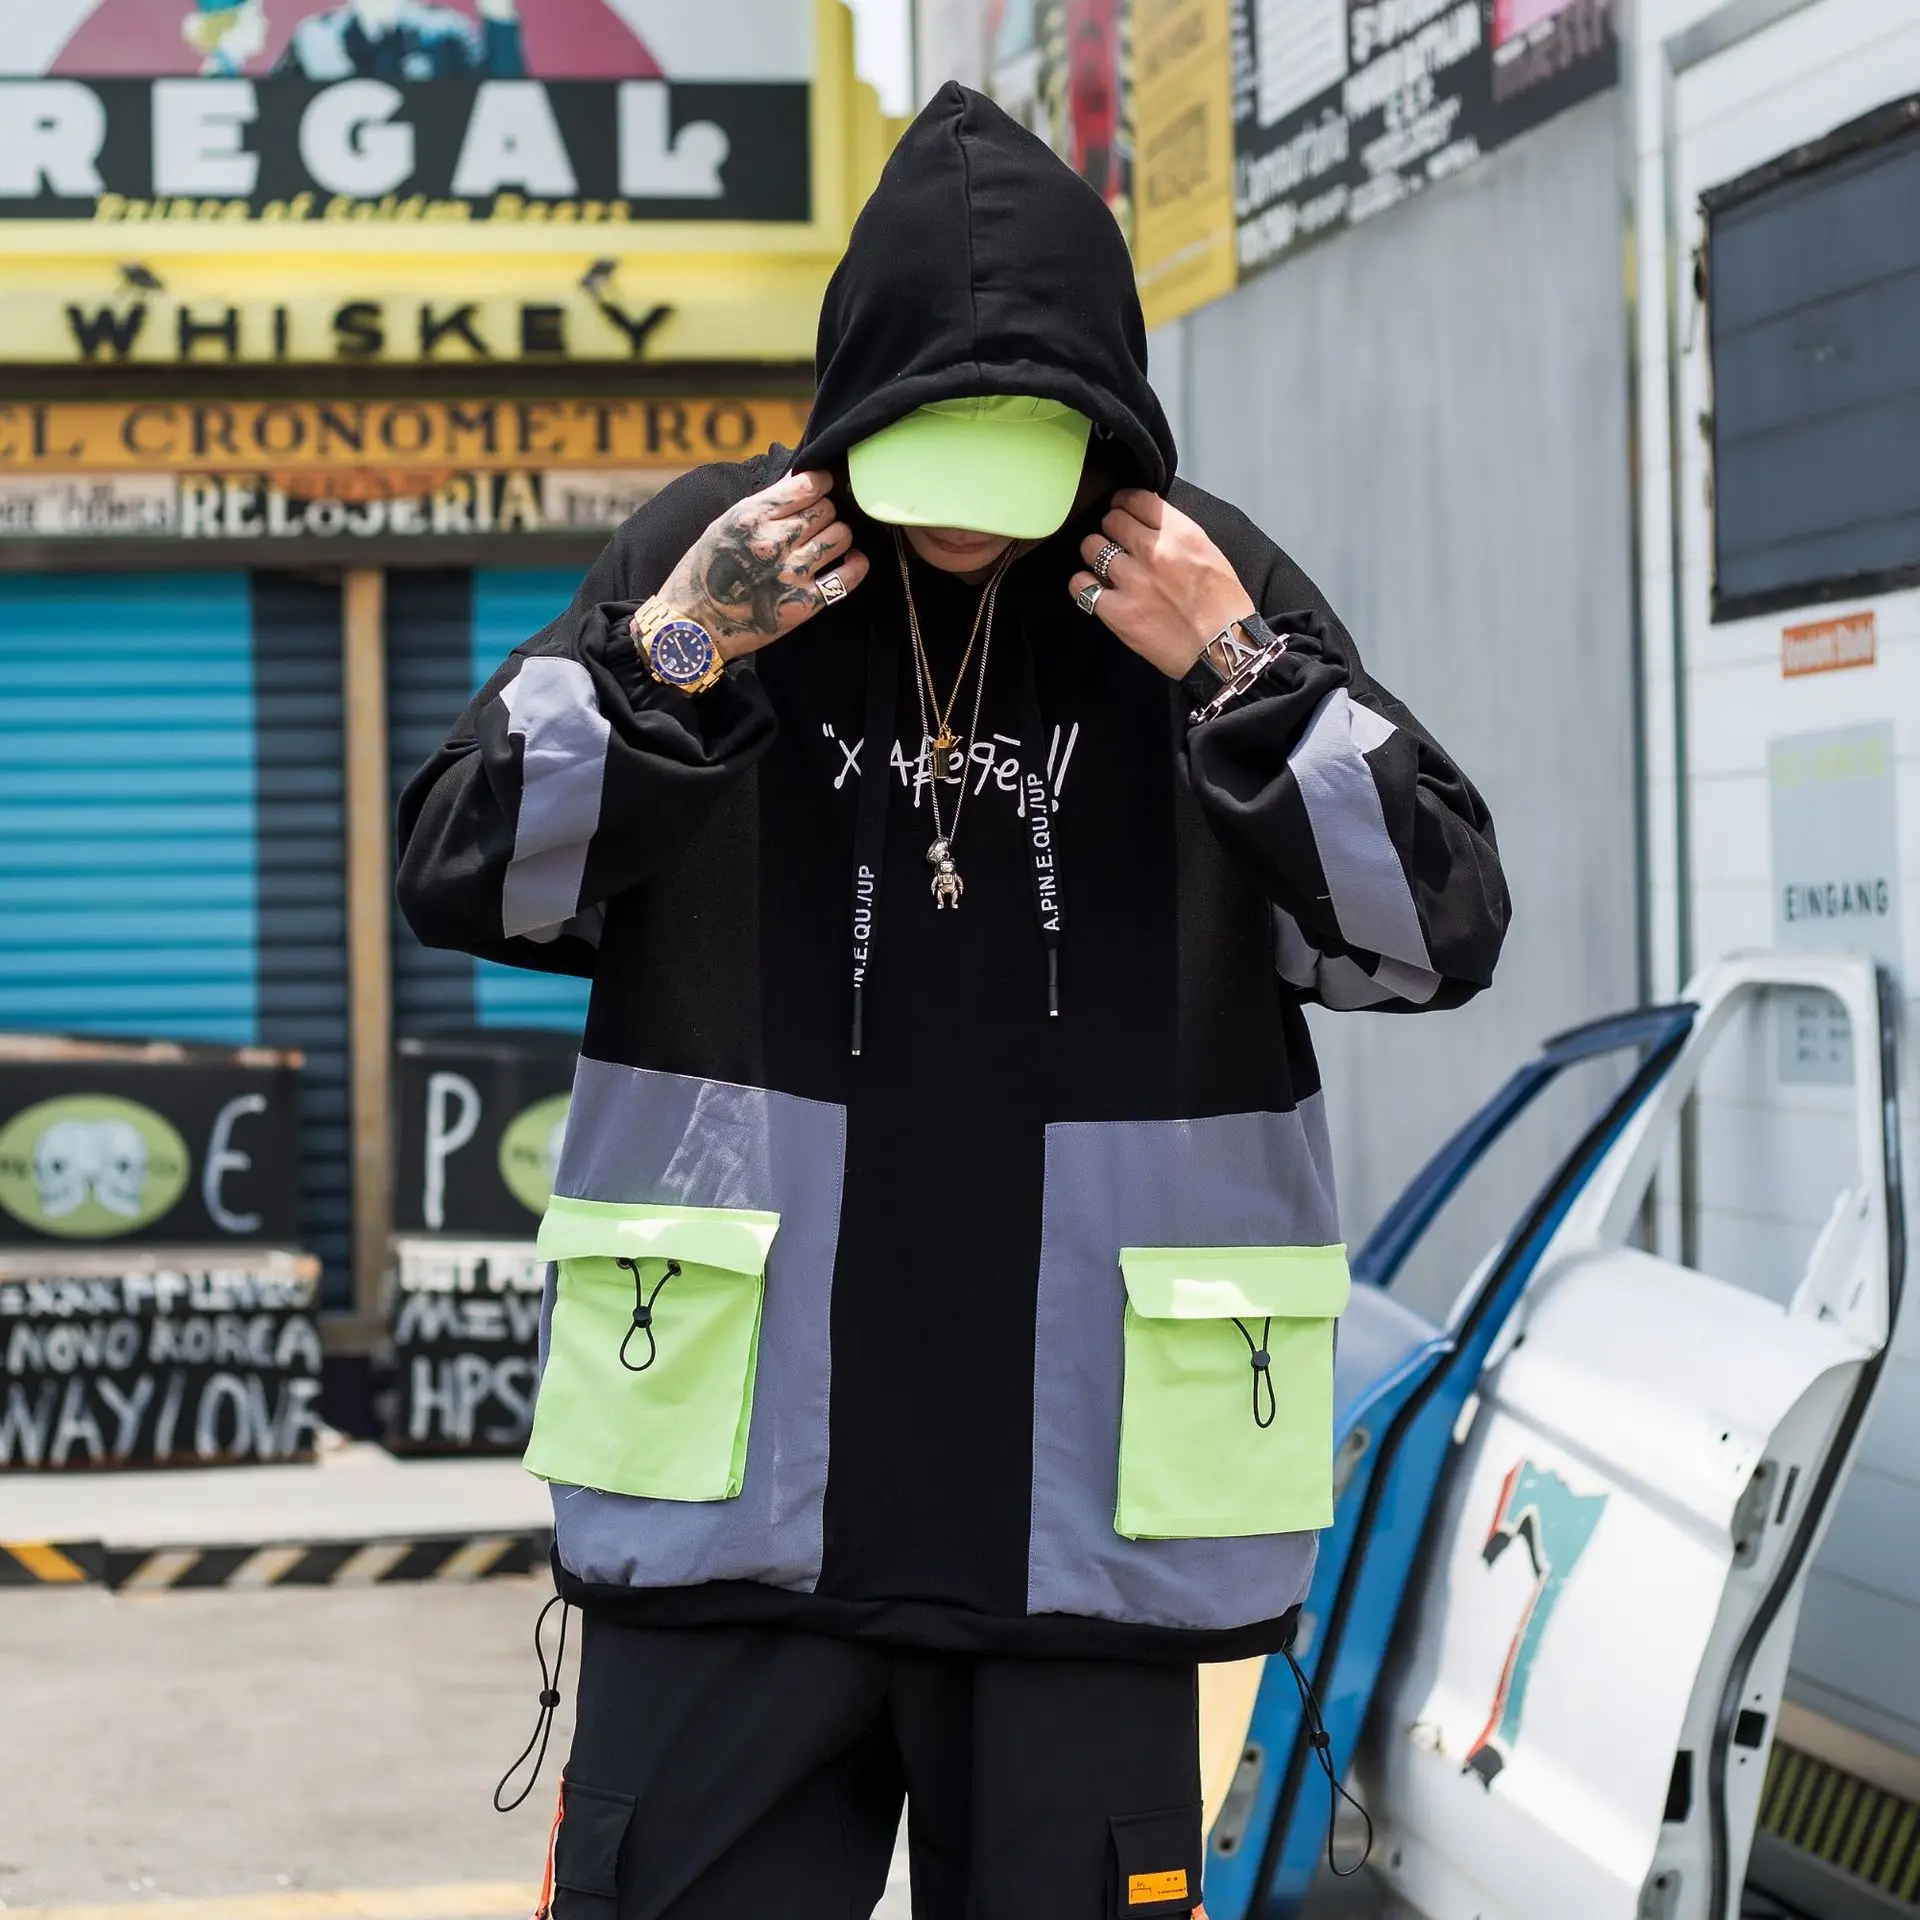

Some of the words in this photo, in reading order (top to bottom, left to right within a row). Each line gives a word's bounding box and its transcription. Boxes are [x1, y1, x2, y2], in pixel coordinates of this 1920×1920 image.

[0, 79, 729, 199] REGAL
[66, 300, 676, 362] WHISKEY
[120, 402, 758, 457] CRONOMETRO
[1784, 876, 1890, 923] EINGANG
